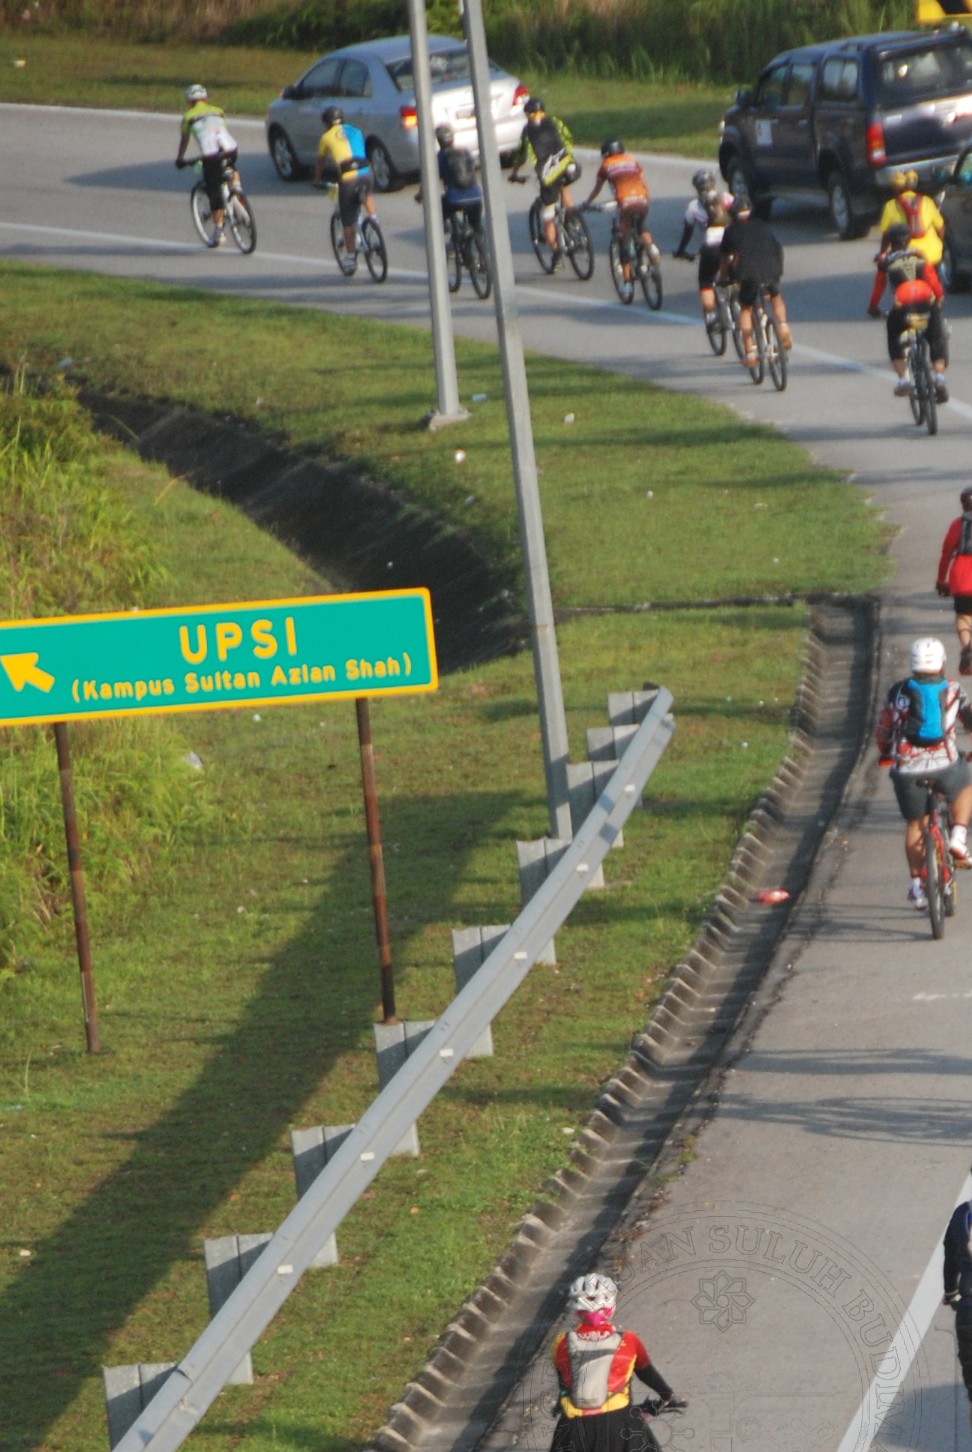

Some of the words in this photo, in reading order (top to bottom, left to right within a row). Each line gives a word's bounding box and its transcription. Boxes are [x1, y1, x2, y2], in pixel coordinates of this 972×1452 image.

[179, 616, 298, 664] UPSI
[72, 677, 176, 703] (Kampus
[185, 671, 261, 693] Sultan
[271, 664, 336, 686] Azlan
[345, 652, 412, 679] Shah)
